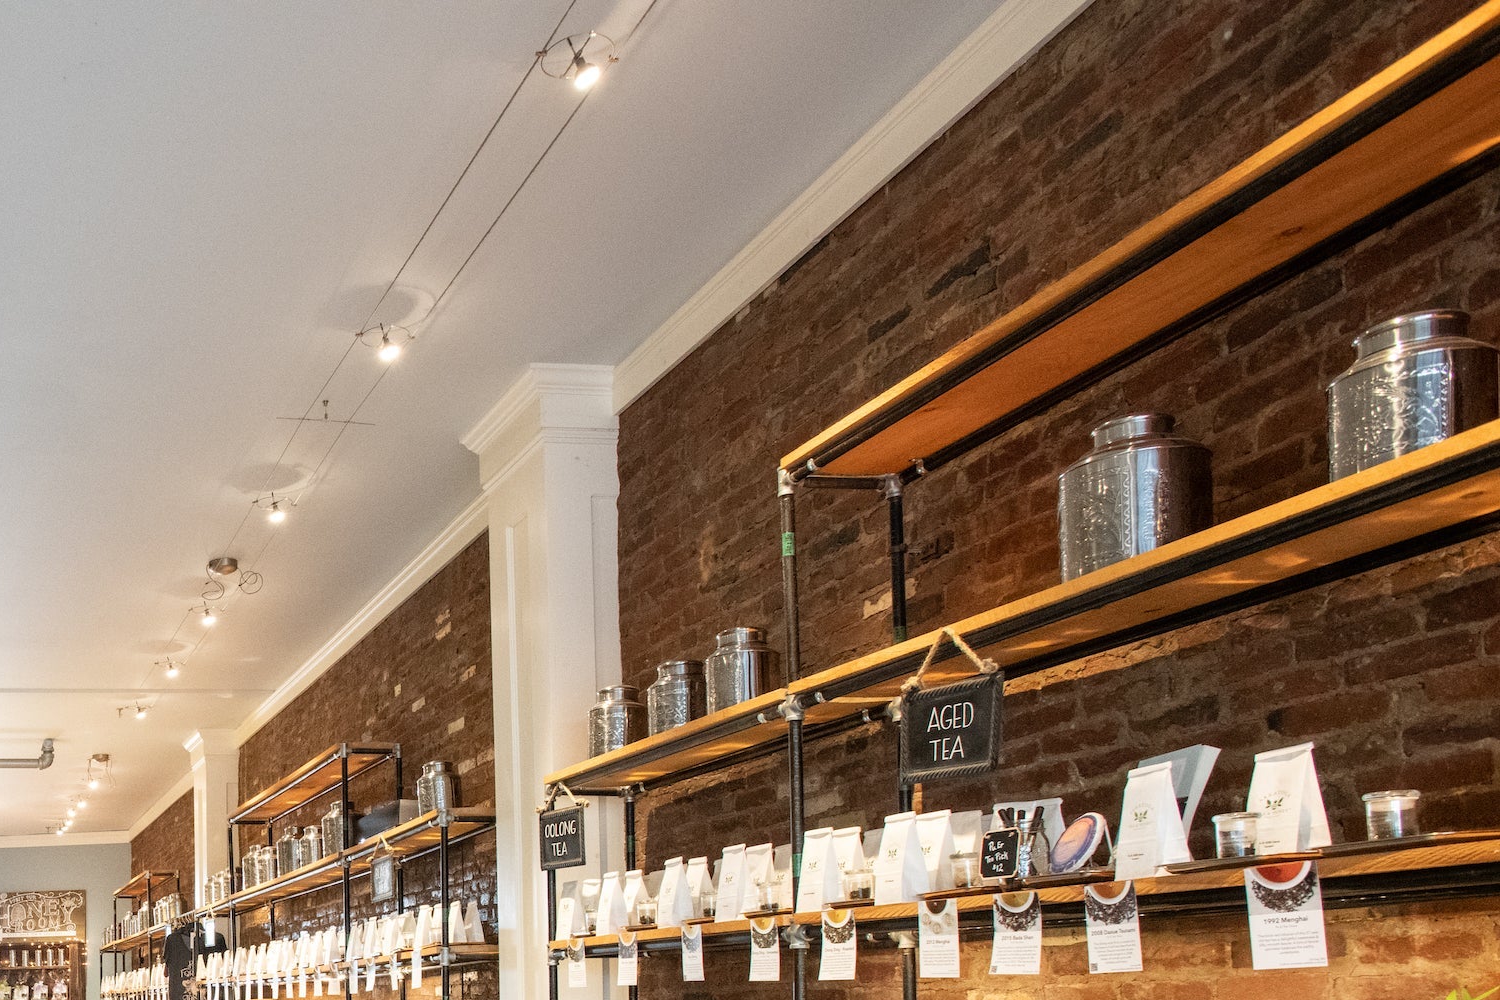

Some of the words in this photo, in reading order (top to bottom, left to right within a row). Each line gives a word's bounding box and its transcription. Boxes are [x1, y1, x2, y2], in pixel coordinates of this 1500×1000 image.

[926, 702, 974, 733] AGED
[929, 735, 965, 762] TEA
[544, 820, 576, 838] OOLONG
[551, 841, 568, 857] TEA
[12, 915, 62, 932] ROOM
[1263, 917, 1280, 925] 1992
[1281, 915, 1308, 924] Menghai
